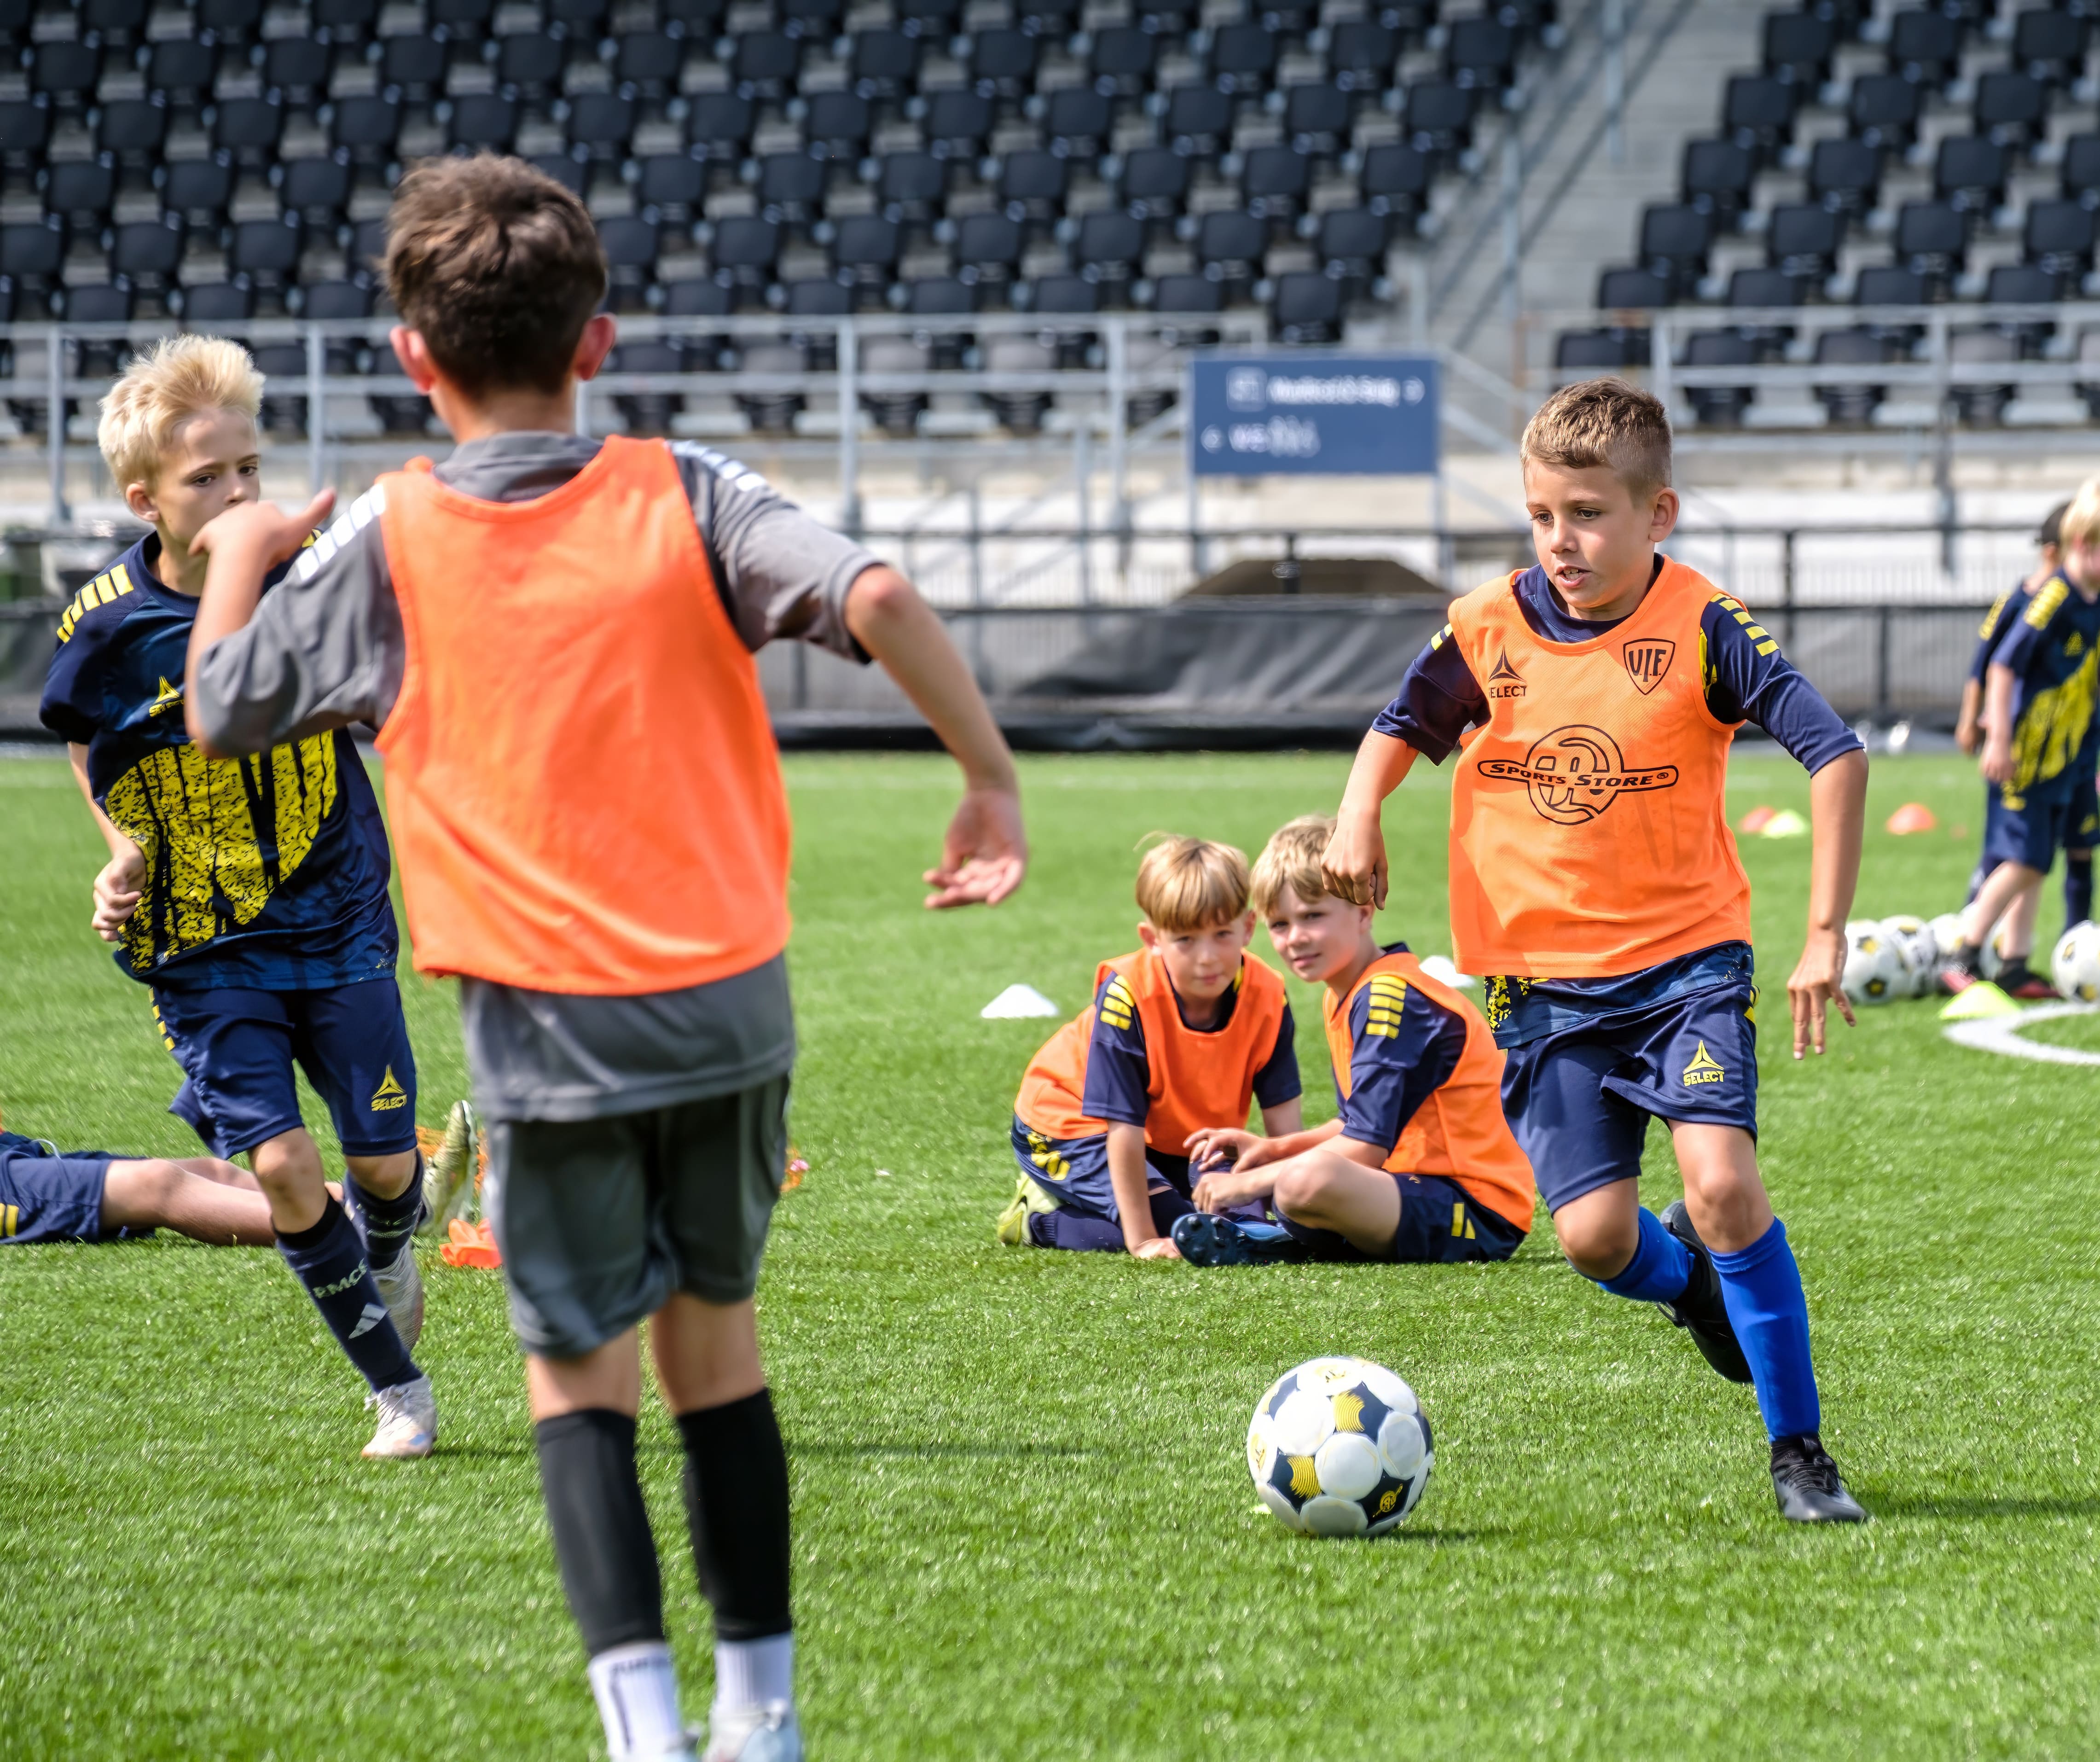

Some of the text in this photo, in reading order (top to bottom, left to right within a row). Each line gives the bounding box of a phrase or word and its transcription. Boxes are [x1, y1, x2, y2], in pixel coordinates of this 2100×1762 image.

[1488, 685, 1527, 698] ELECT
[1490, 764, 1653, 787] SPORTS STORE
[1683, 1070, 1725, 1087] SELECT
